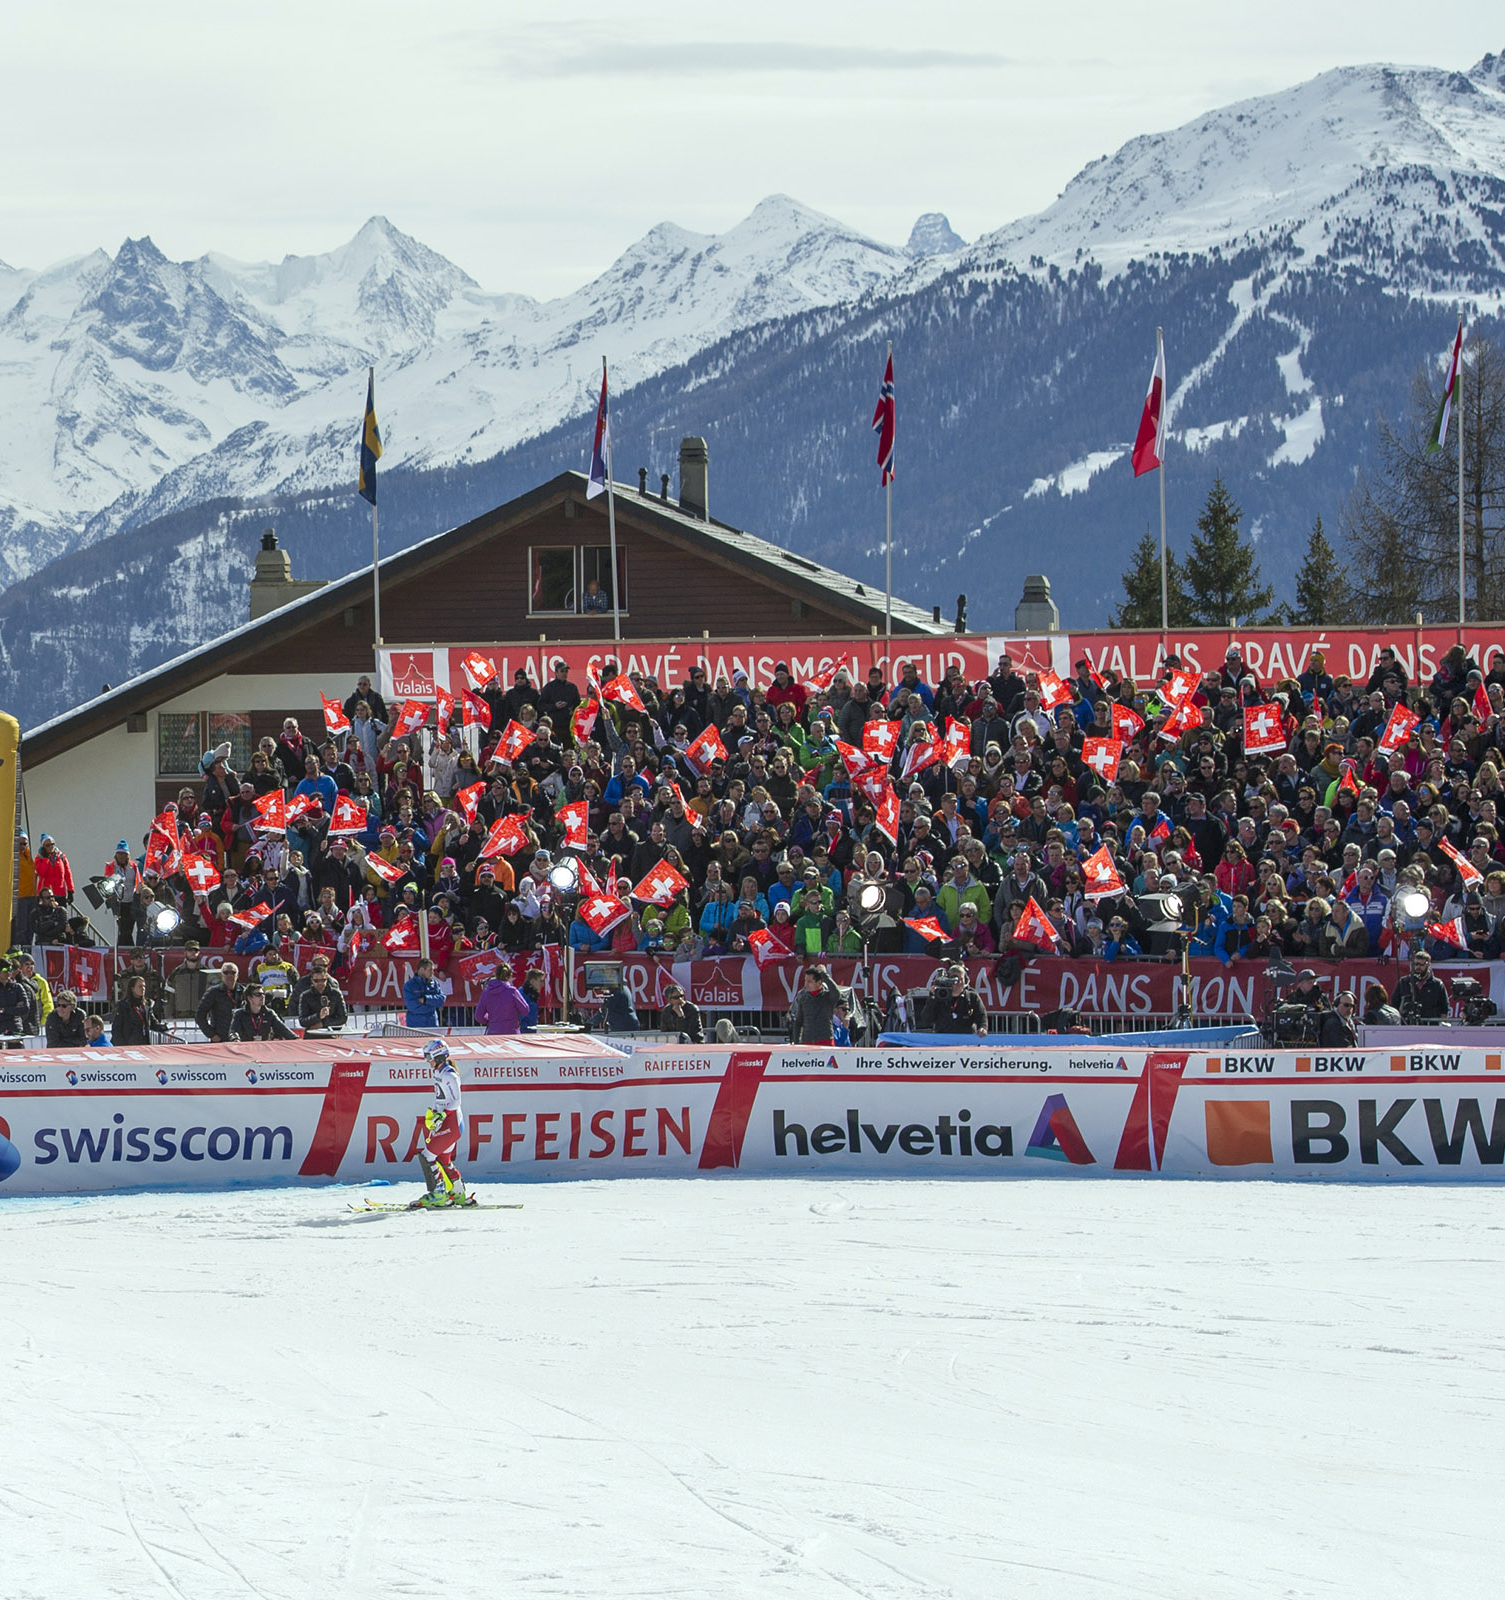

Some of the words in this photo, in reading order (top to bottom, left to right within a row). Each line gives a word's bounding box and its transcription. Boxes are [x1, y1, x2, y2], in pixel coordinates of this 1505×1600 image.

[696, 655, 776, 691] DANS
[395, 681, 433, 695] Valais
[694, 985, 740, 1003] Valais
[1058, 970, 1153, 1014] DANS
[474, 1066, 539, 1078] RAIFFEISEN
[559, 1066, 624, 1078] RAIFFEISEN
[644, 1059, 711, 1072] RAIFFEISEN
[781, 1058, 825, 1069] helvetia
[856, 1057, 884, 1069] Ihre
[887, 1057, 956, 1070] Schweizer
[960, 1057, 1053, 1072] Versicherung.
[1069, 1058, 1114, 1070] helvetia
[1224, 1056, 1275, 1073] BKW
[1314, 1056, 1366, 1073] BKW
[1410, 1054, 1461, 1072] BKW
[80, 1070, 137, 1083] swisscom
[170, 1069, 227, 1082] swisscom
[259, 1068, 315, 1081] swisscom
[33, 1113, 293, 1165] swisscom
[772, 1108, 1014, 1157] helvetia
[1290, 1098, 1505, 1166] BKW
